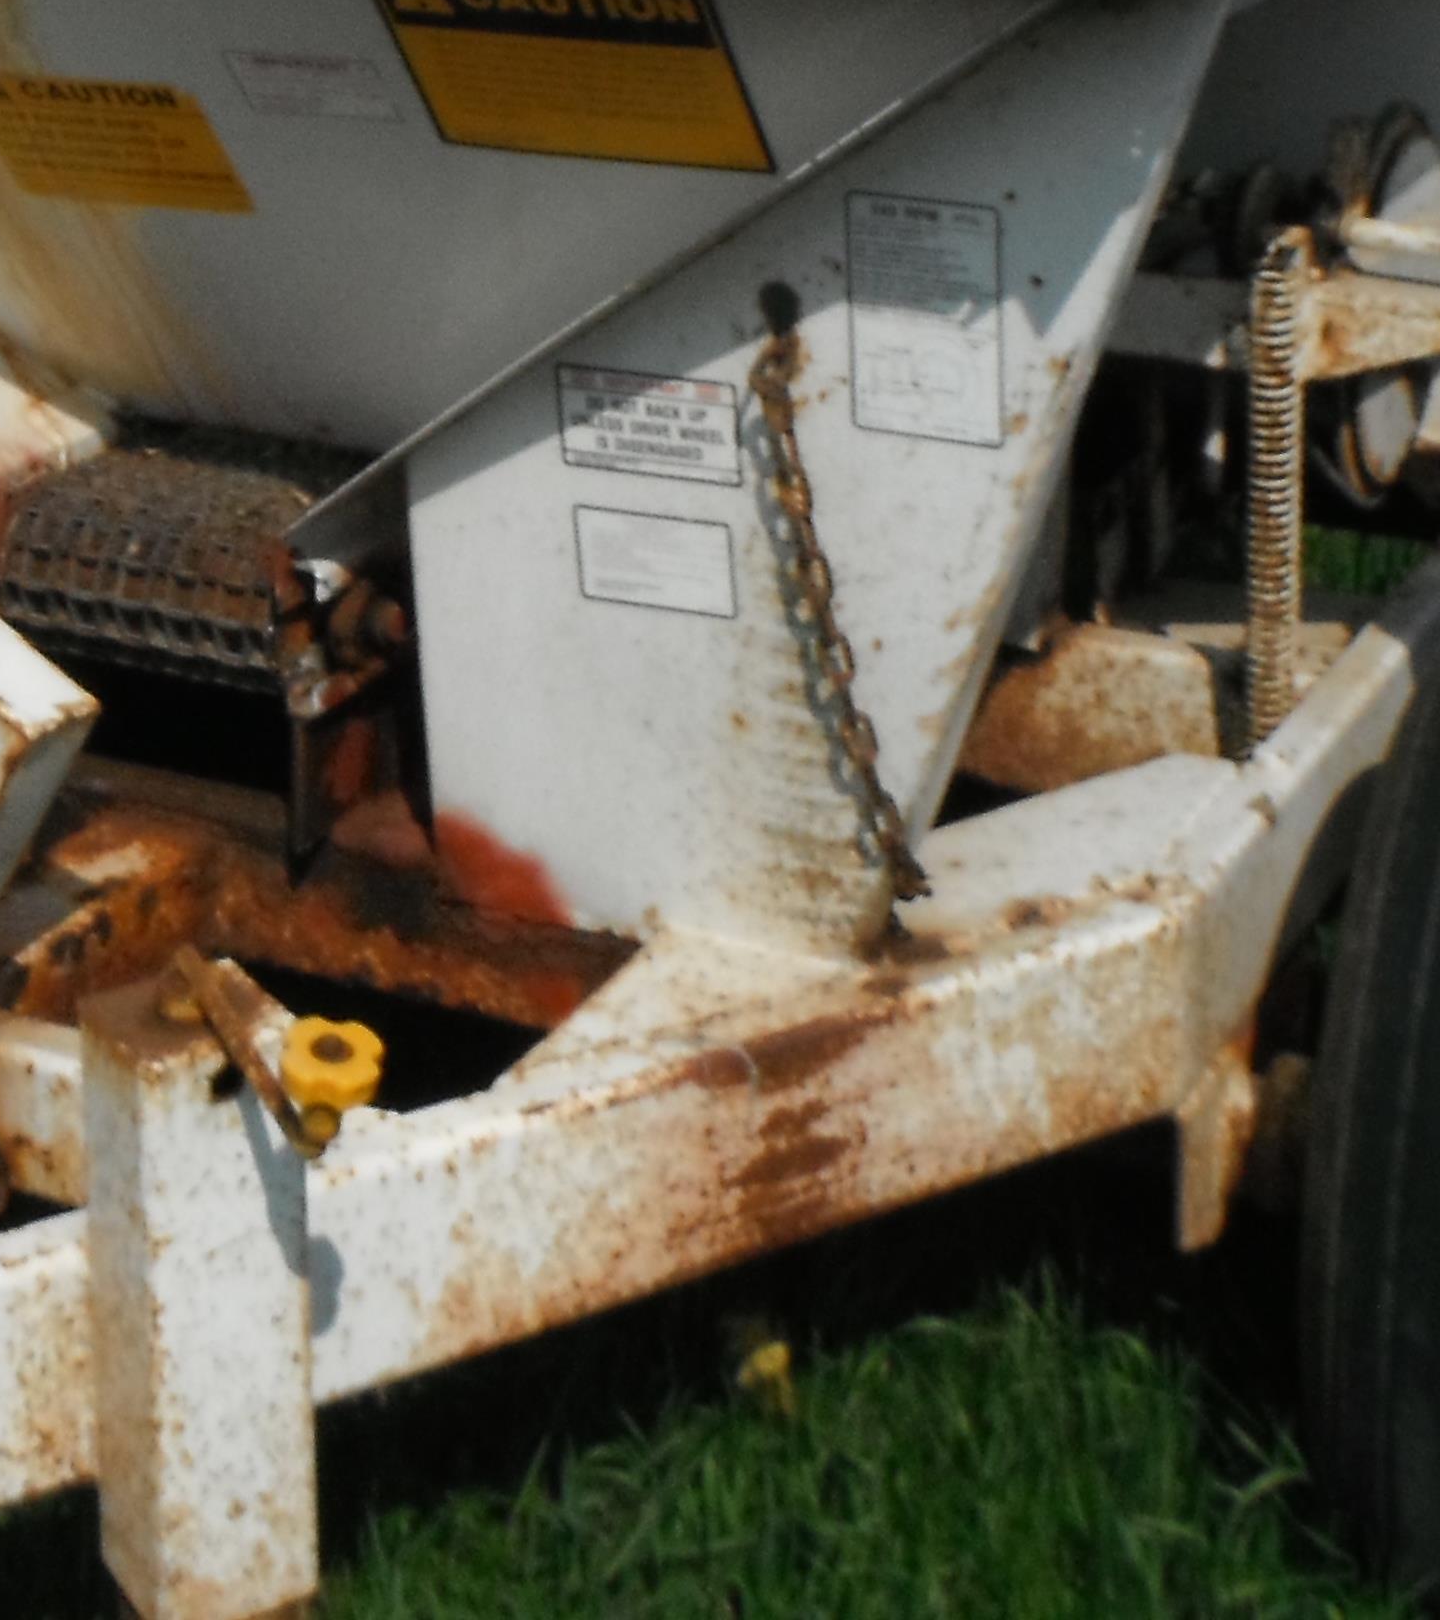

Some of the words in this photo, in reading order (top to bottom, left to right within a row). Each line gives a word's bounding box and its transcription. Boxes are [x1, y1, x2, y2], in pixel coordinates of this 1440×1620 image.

[20, 80, 178, 108] CAUTION
[645, 402, 681, 420] BACK
[687, 407, 708, 422] UP
[629, 420, 672, 439] DRIVE
[678, 427, 726, 446] WHEEL
